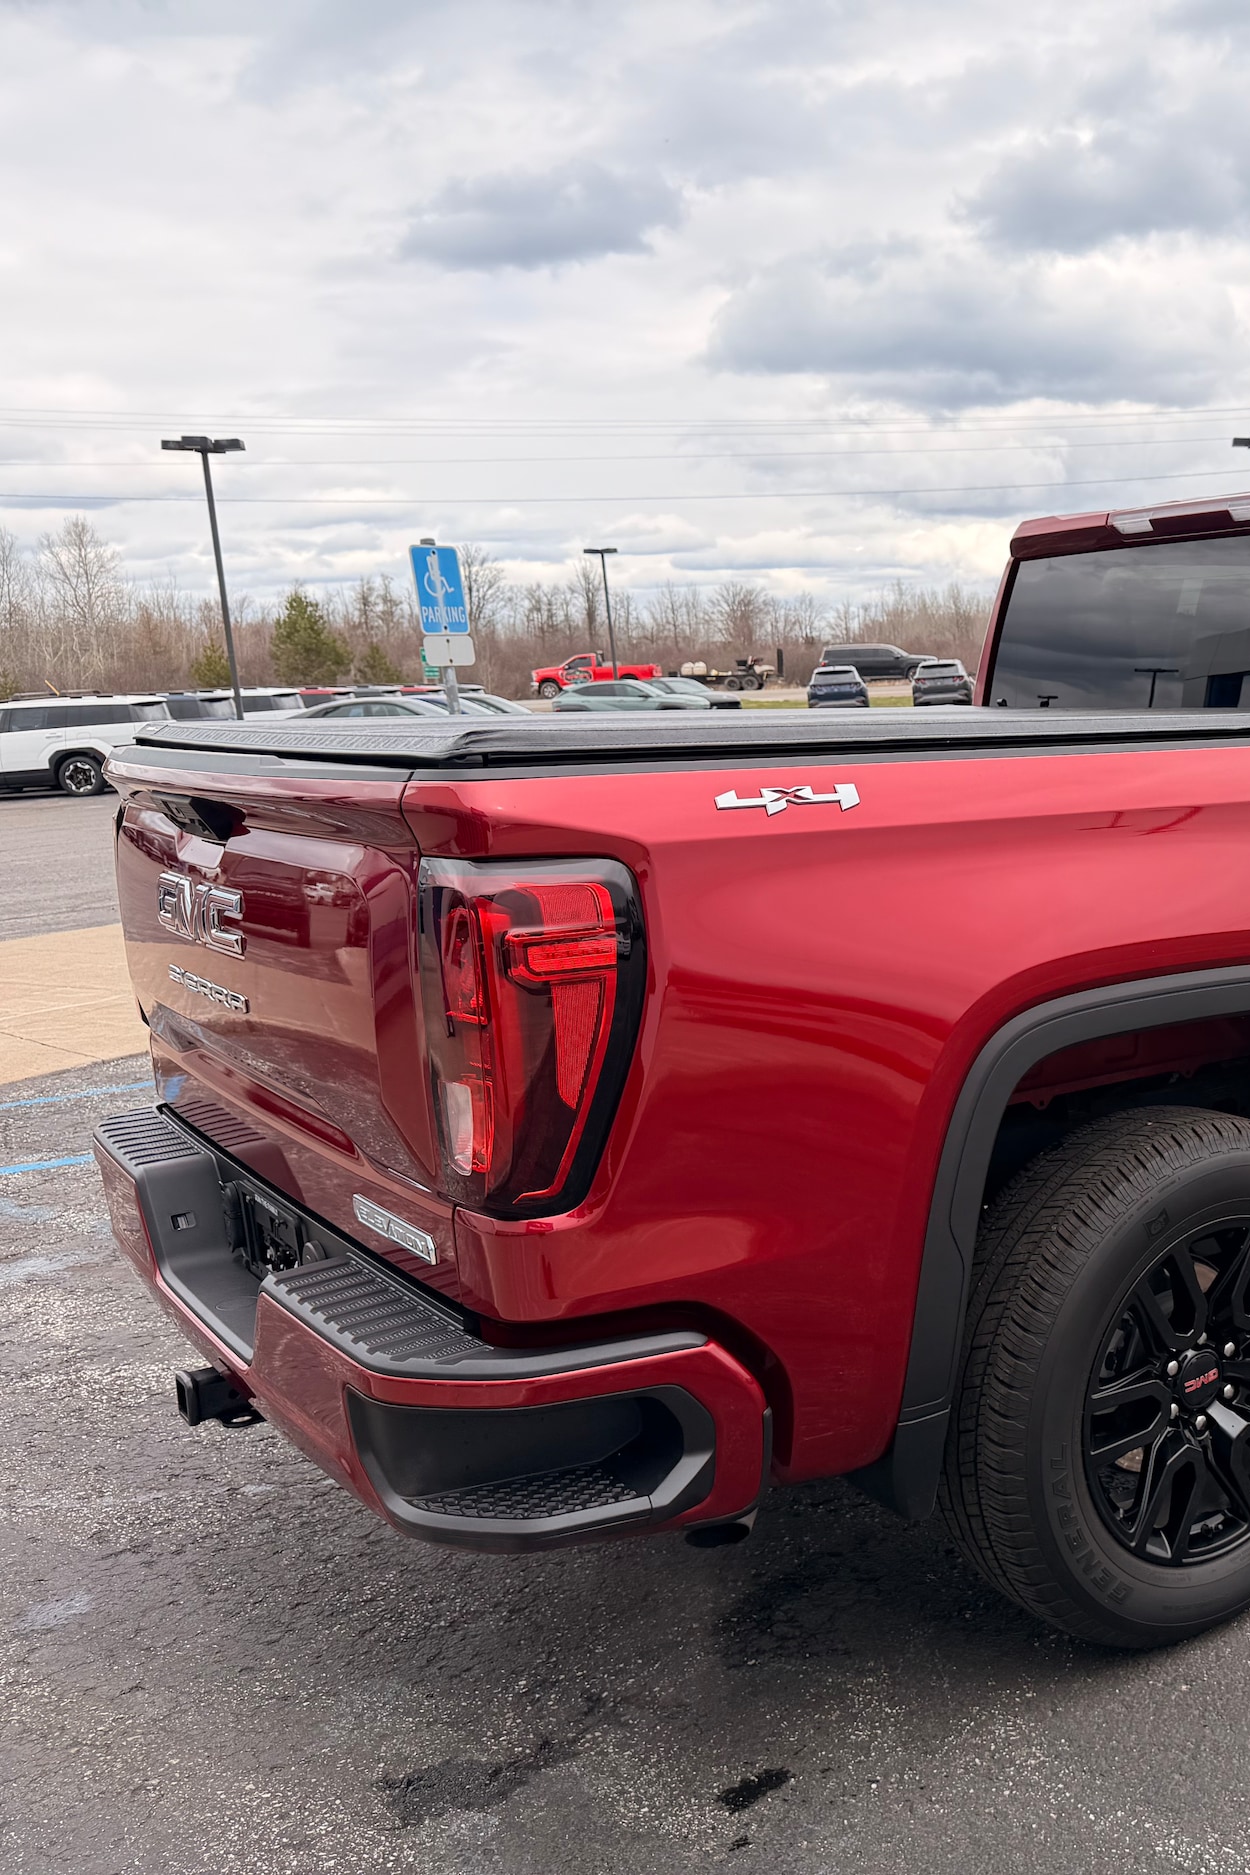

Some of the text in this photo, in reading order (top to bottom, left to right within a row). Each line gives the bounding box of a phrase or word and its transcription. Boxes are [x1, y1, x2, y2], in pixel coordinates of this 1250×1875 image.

[421, 606, 466, 624] PARKING
[158, 870, 247, 960] GMC
[168, 963, 249, 1014] SIERRA
[356, 1203, 431, 1257] ELEVATION
[1184, 1367, 1219, 1393] GMC
[1050, 1442, 1134, 1606] GENERAL
